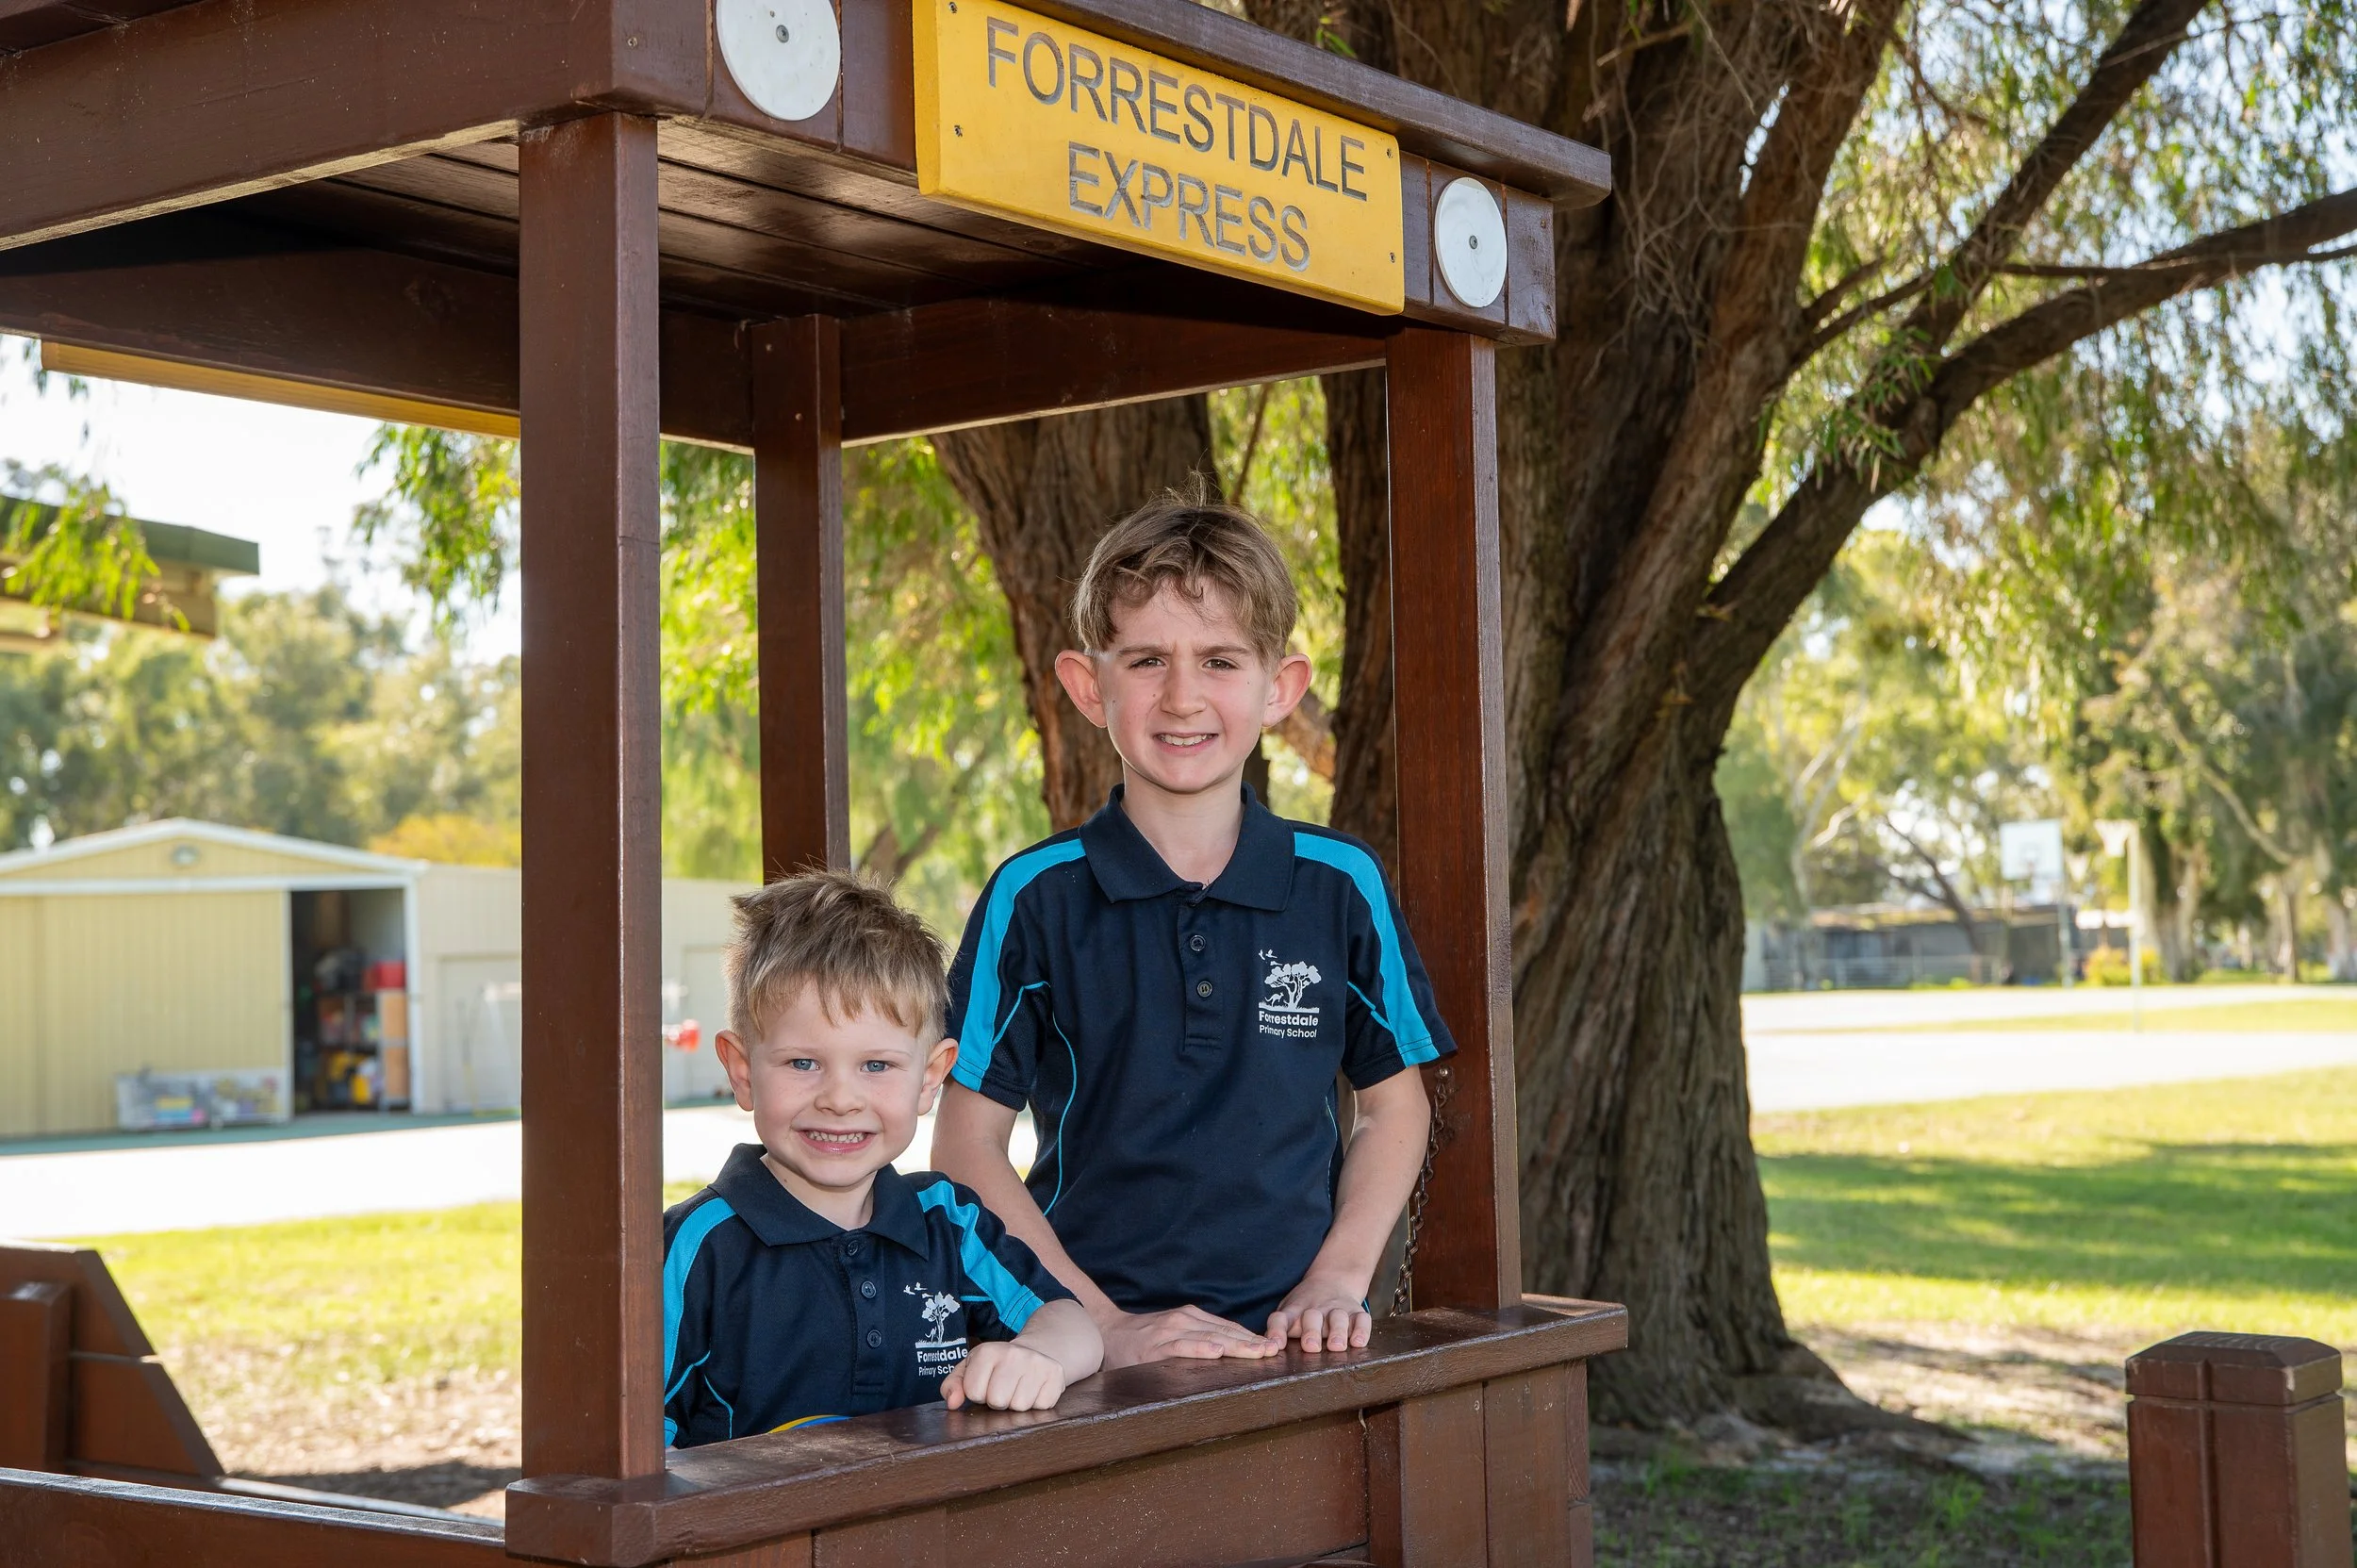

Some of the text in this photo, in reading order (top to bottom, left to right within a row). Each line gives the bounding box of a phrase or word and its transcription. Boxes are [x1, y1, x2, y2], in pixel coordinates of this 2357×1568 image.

[987, 16, 1367, 202] FORRESTDALE
[1068, 140, 1310, 272] EXPRESS
[1259, 1011, 1318, 1026] Forrestdale
[1260, 1025, 1317, 1038] Primary School
[917, 1347, 967, 1362] Forrestdale
[918, 1364, 954, 1377] Primary Sch
